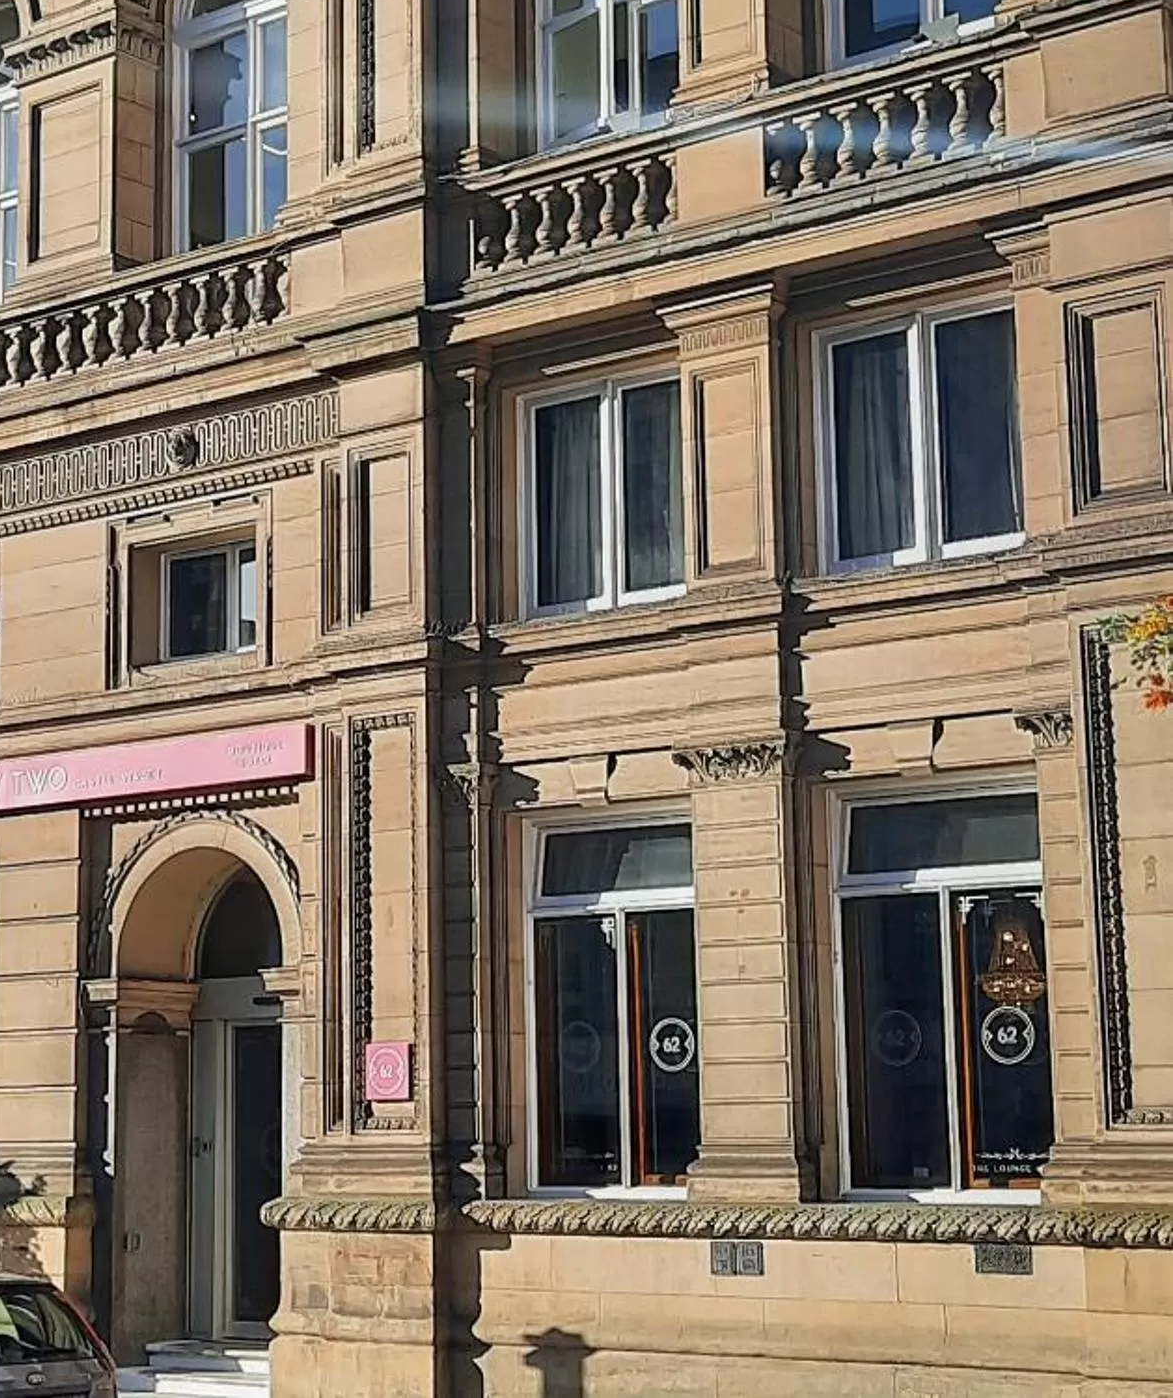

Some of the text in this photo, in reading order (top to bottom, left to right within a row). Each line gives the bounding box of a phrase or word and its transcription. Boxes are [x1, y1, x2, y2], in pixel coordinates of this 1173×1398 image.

[11, 765, 68, 795] TWO
[996, 1025, 1018, 1045] 62
[662, 1036, 681, 1053] 62
[380, 1064, 393, 1079] 62
[993, 1164, 1032, 1174] LOUNGE
